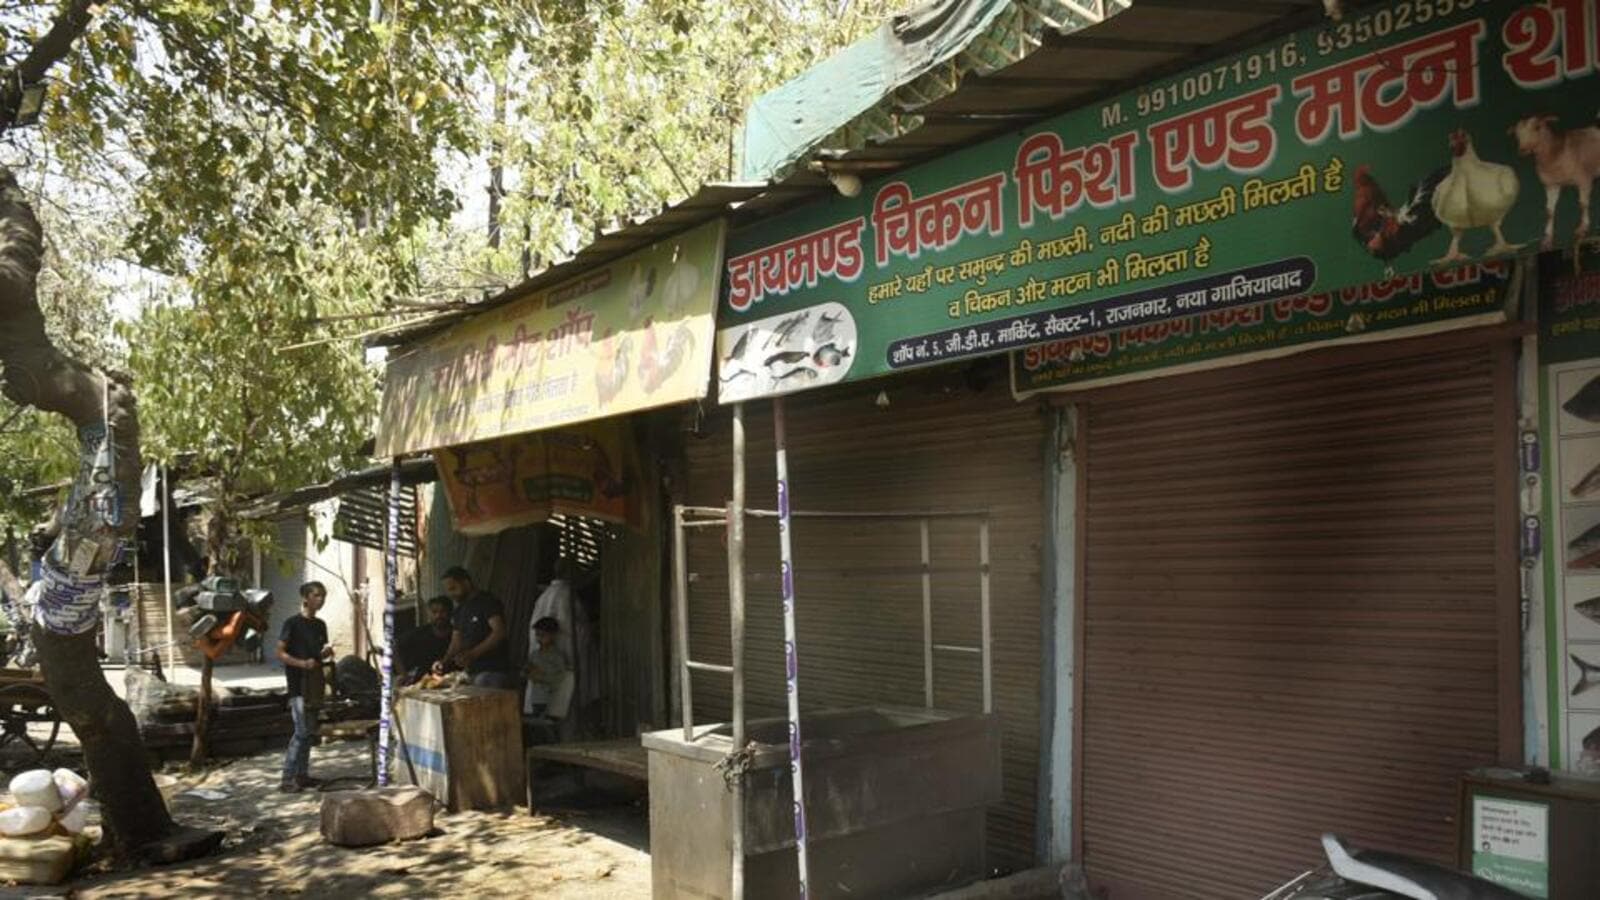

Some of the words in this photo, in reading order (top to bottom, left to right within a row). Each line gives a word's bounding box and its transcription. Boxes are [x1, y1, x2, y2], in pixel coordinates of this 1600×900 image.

[1101, 103, 1129, 128] M.
[1136, 40, 1306, 116] 9910071916,
[728, 218, 864, 311] डायमण्ड
[873, 174, 1006, 268] चिकन
[1014, 131, 1138, 230] फिश
[1149, 85, 1282, 192] एण्ड
[1293, 20, 1485, 142] मटन
[1502, 0, 1600, 88] श
[868, 276, 903, 304] हमारे
[905, 266, 932, 293] यहाँ
[936, 266, 954, 285] पर
[1010, 239, 1034, 267] की
[1099, 213, 1135, 244] नदी
[1141, 205, 1169, 235] की
[1175, 187, 1237, 225] मछली
[1243, 164, 1317, 210] मिलती
[1323, 158, 1343, 191] है
[949, 300, 961, 318] व
[965, 288, 1012, 314] चिकन
[1015, 277, 1047, 304] और
[1051, 271, 1092, 297] मटन
[1097, 253, 1120, 286] भी
[1124, 249, 1188, 280] मिलता
[1194, 236, 1212, 268] है
[893, 343, 914, 364] शॉप
[1106, 298, 1172, 325] राजनगर,
[1176, 290, 1207, 309] नया
[1210, 270, 1304, 304] गाजियाबाद
